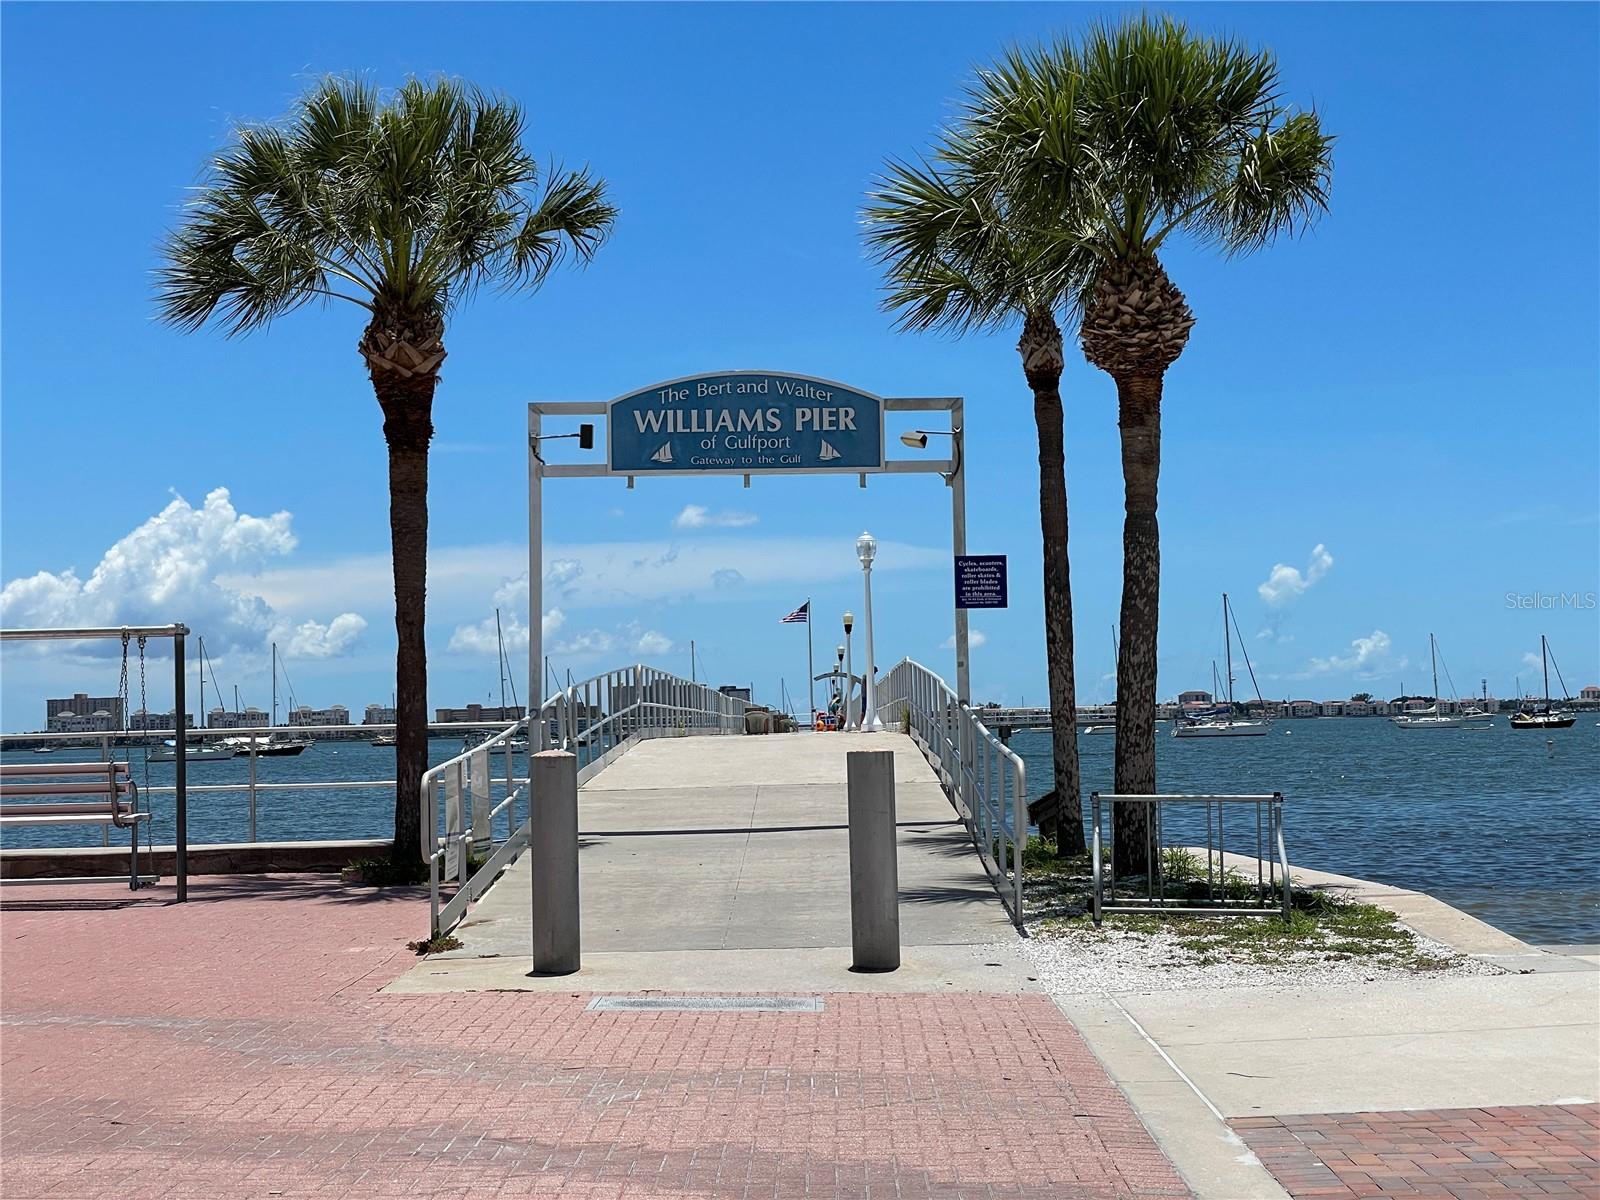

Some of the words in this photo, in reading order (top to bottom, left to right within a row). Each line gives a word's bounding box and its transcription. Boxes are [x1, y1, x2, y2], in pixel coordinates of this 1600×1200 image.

[657, 388, 689, 404] The
[697, 382, 732, 397] Bert
[736, 379, 768, 394] and
[776, 380, 833, 402] Walter
[633, 408, 782, 433] WILLIAMS
[795, 407, 857, 431] PIER
[700, 434, 717, 449] of
[725, 434, 791, 452] Gulfport
[690, 455, 736, 465] Gateway
[741, 456, 753, 464] to
[758, 455, 775, 464] the
[780, 454, 802, 464] Gulf
